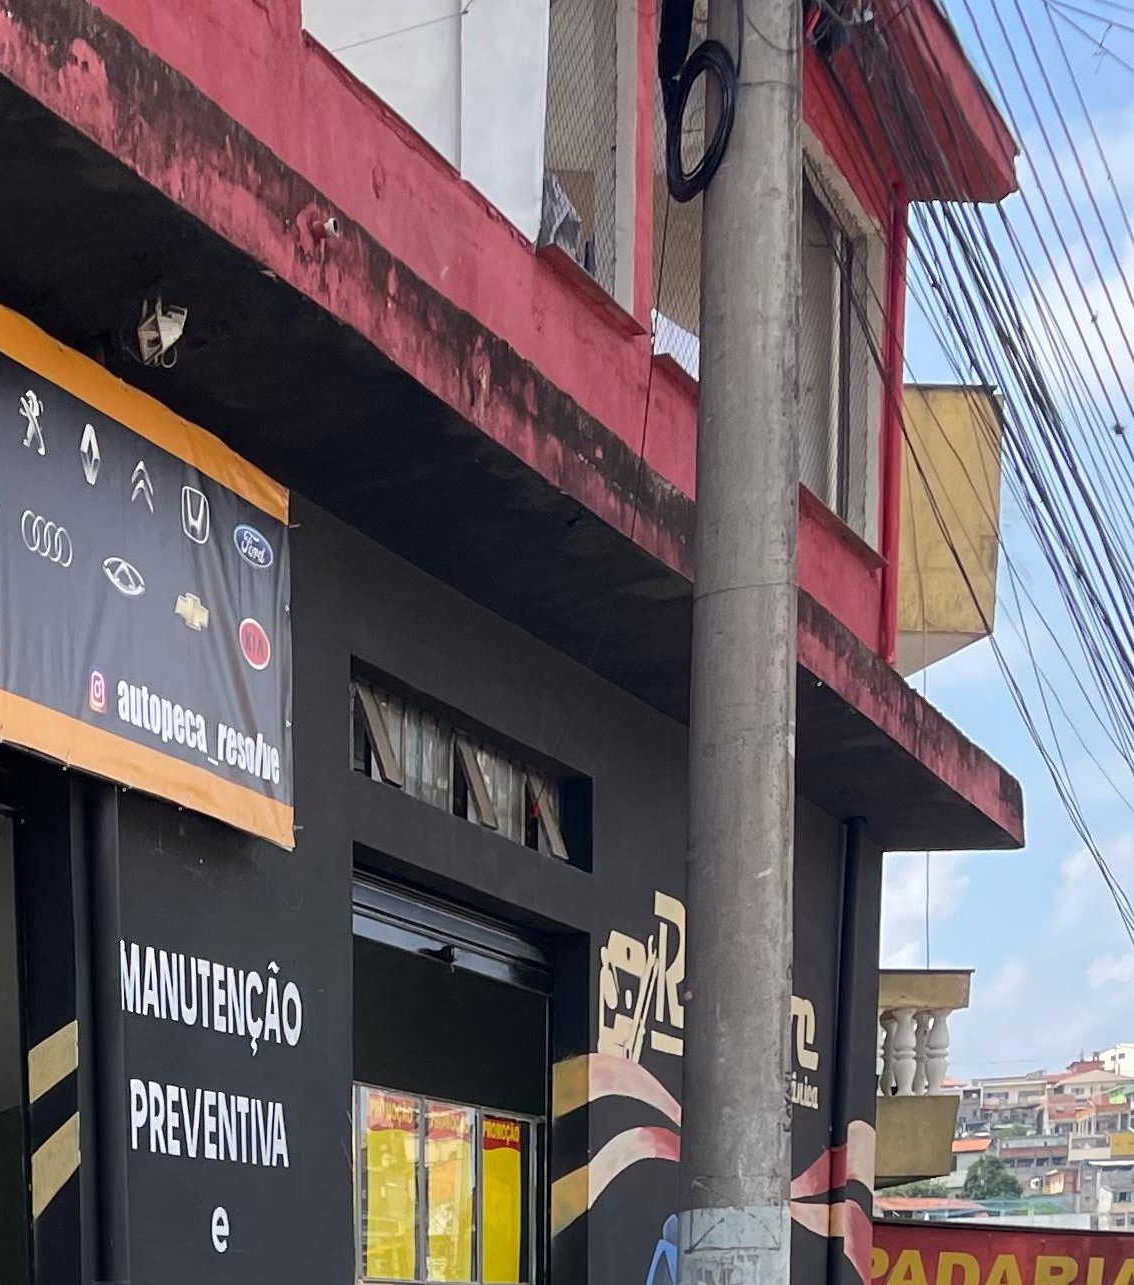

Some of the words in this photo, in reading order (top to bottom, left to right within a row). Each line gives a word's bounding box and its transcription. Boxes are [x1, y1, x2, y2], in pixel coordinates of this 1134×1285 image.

[240, 530, 266, 564] Ford
[117, 680, 281, 785] autopeca_resolve
[129, 1078, 290, 1168] PREVENTIVA
[211, 1206, 230, 1253] e
